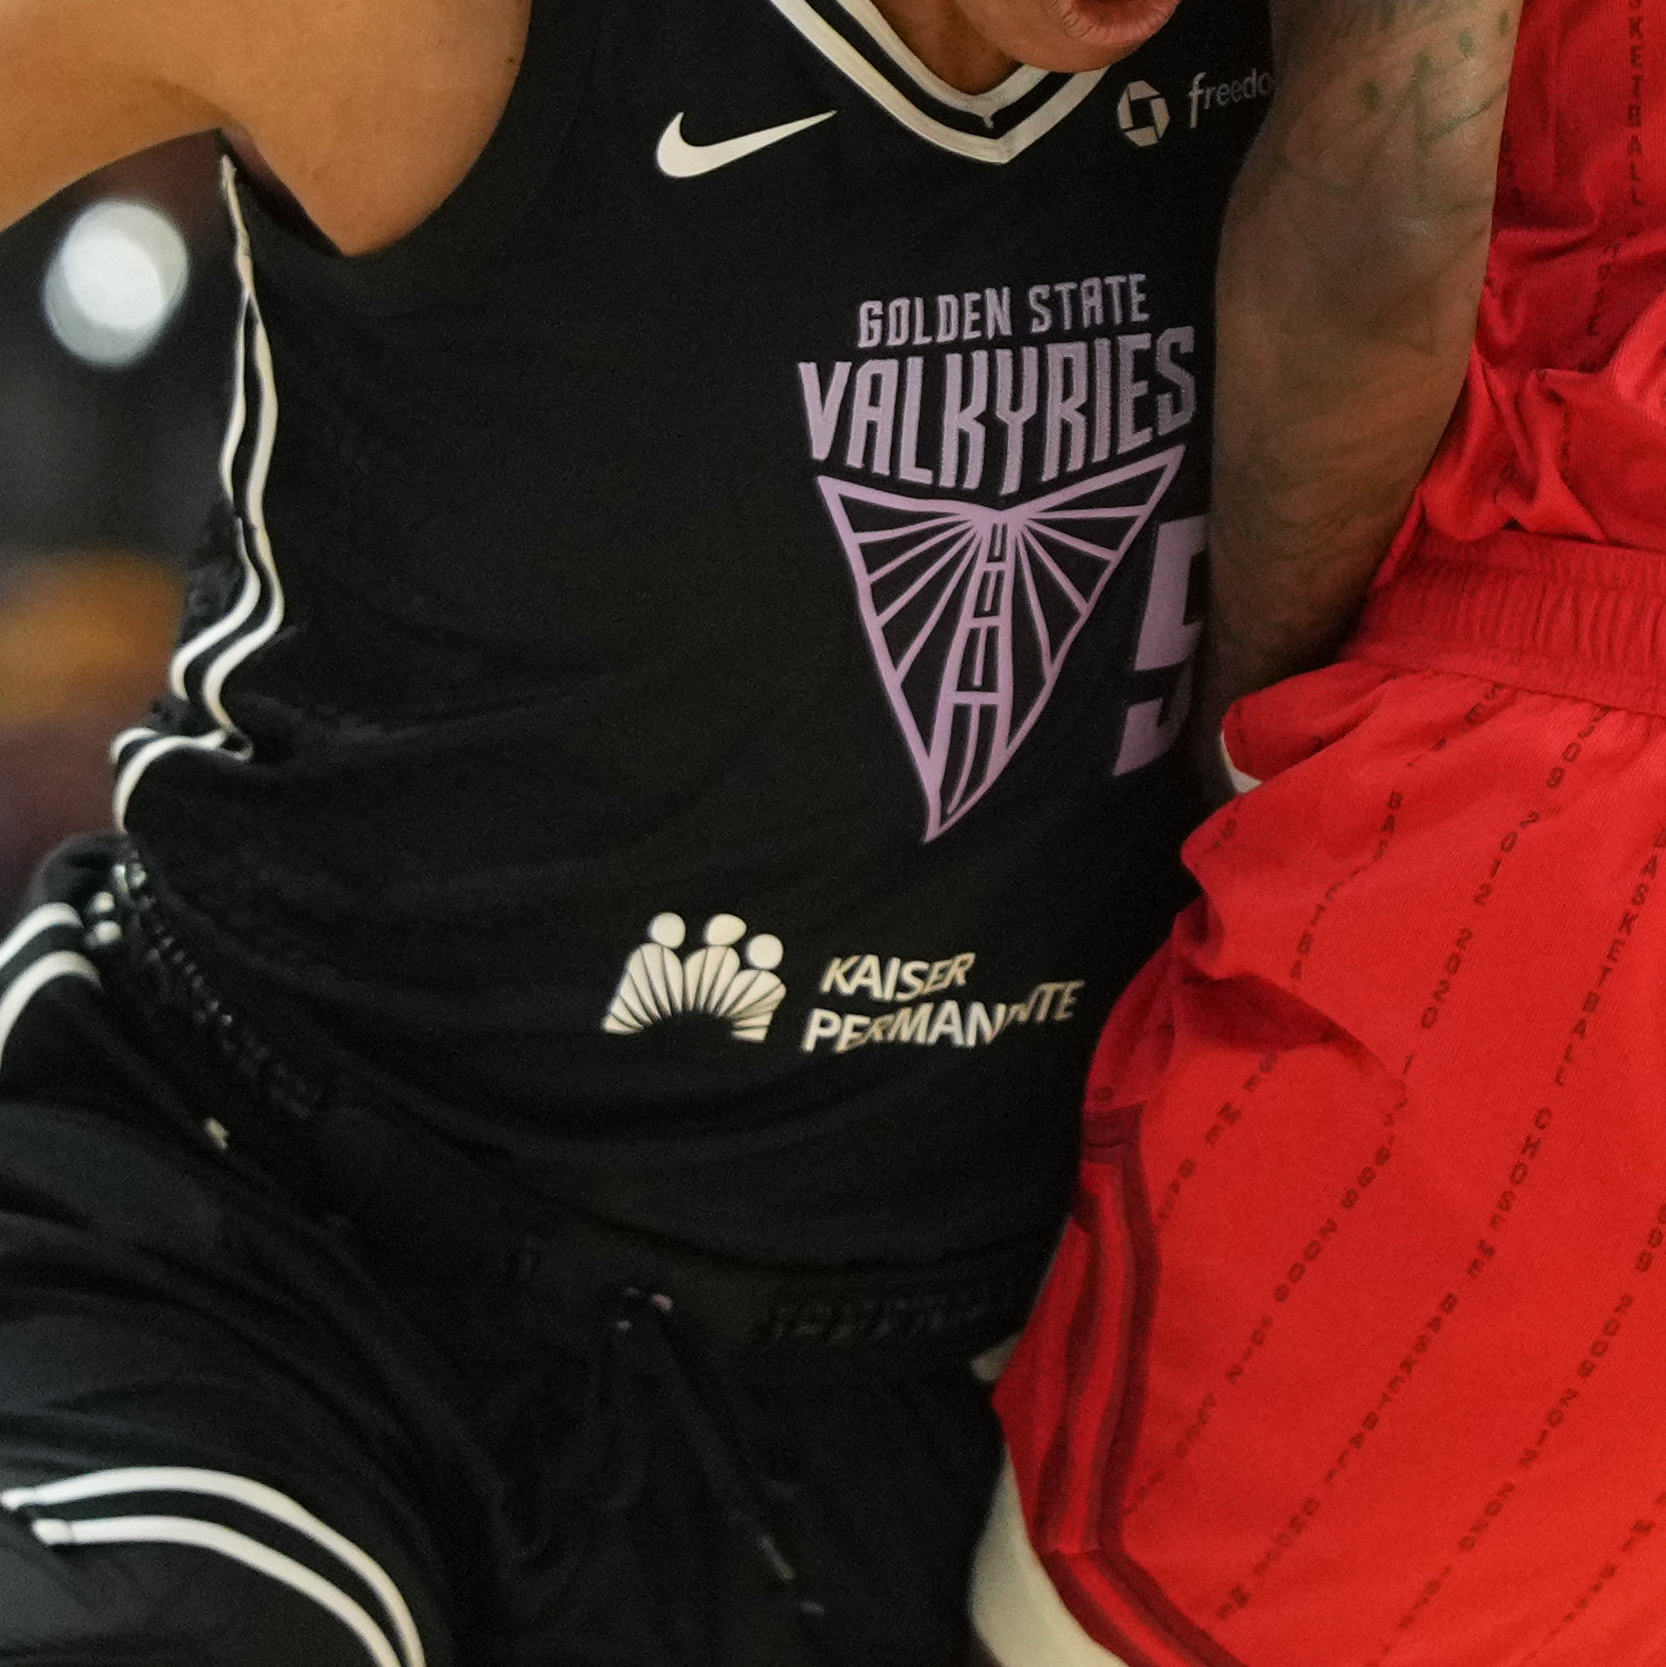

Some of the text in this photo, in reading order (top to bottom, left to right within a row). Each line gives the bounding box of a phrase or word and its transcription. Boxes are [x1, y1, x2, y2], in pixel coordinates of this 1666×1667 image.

[1188, 68, 1275, 128] freedo
[857, 272, 1150, 349] GOLDEN STATE
[797, 325, 1196, 496] VALKYRIES
[1112, 514, 1209, 777] 5
[1474, 809, 1541, 907] 2012
[820, 952, 976, 1003] KAISER
[1420, 927, 1474, 1030] 2020
[1490, 1106, 1554, 1230] CHOSE
[1577, 1293, 1634, 1379] 2009
[1519, 1387, 1579, 1468] 2012
